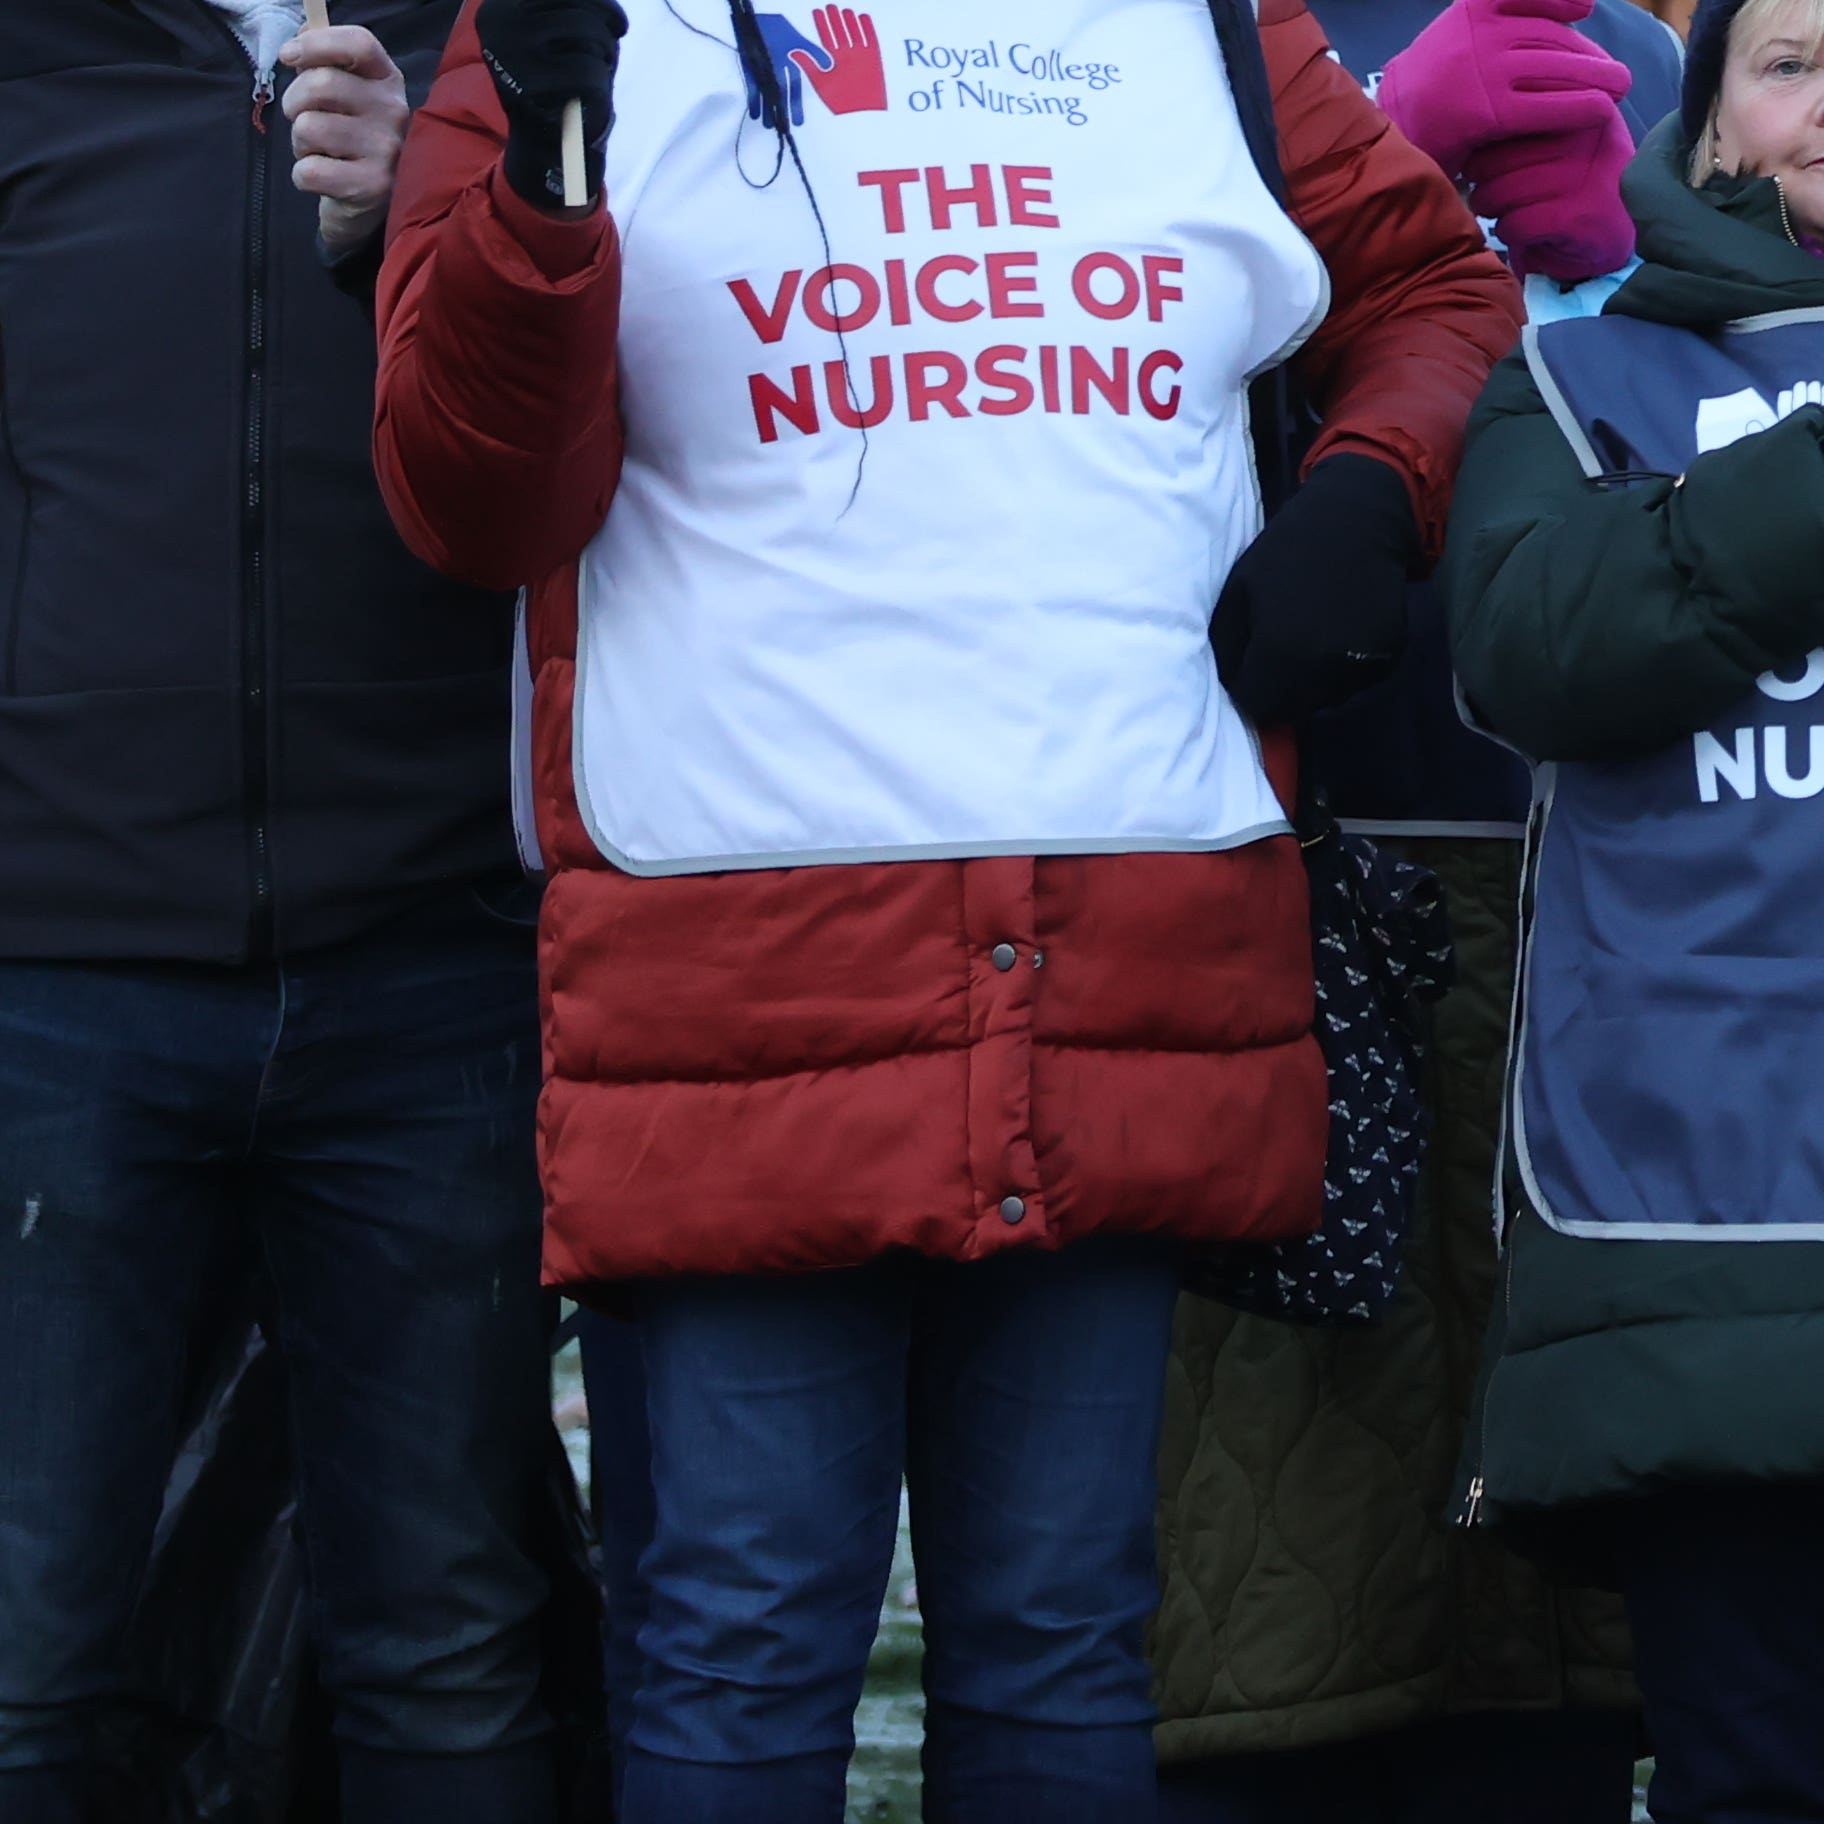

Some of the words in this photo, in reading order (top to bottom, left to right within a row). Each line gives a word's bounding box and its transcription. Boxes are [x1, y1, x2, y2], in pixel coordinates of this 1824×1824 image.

[904, 38, 1000, 78] Royal
[1008, 43, 1123, 91] College
[908, 80, 945, 113] of
[956, 81, 1088, 126] Nursing
[857, 163, 1061, 235] THE
[725, 251, 1045, 345] VOICE
[1071, 251, 1184, 323] OF
[748, 344, 1184, 445] NURSING
